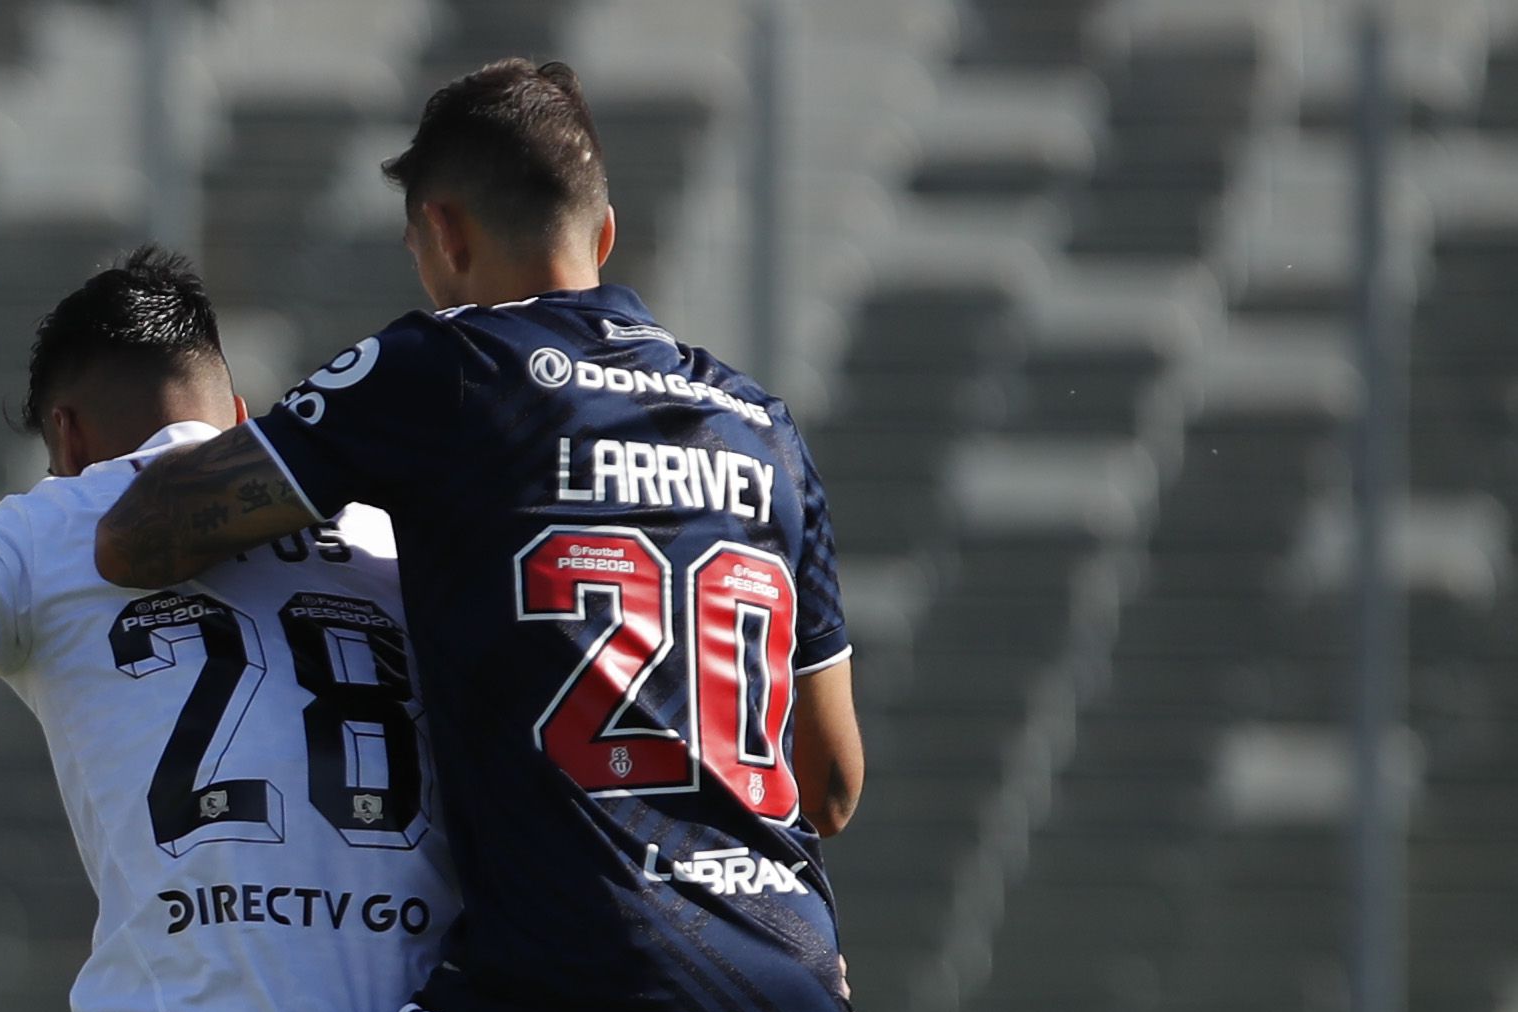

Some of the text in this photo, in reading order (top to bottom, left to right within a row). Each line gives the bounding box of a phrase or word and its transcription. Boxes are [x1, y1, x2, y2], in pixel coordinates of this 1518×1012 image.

[576, 360, 772, 427] DONGFENG
[558, 437, 774, 524] LARRIVEY
[558, 557, 635, 573] PES2021
[513, 524, 801, 827] 20
[108, 590, 434, 858] 28
[157, 884, 431, 935] DIRECTV GO
